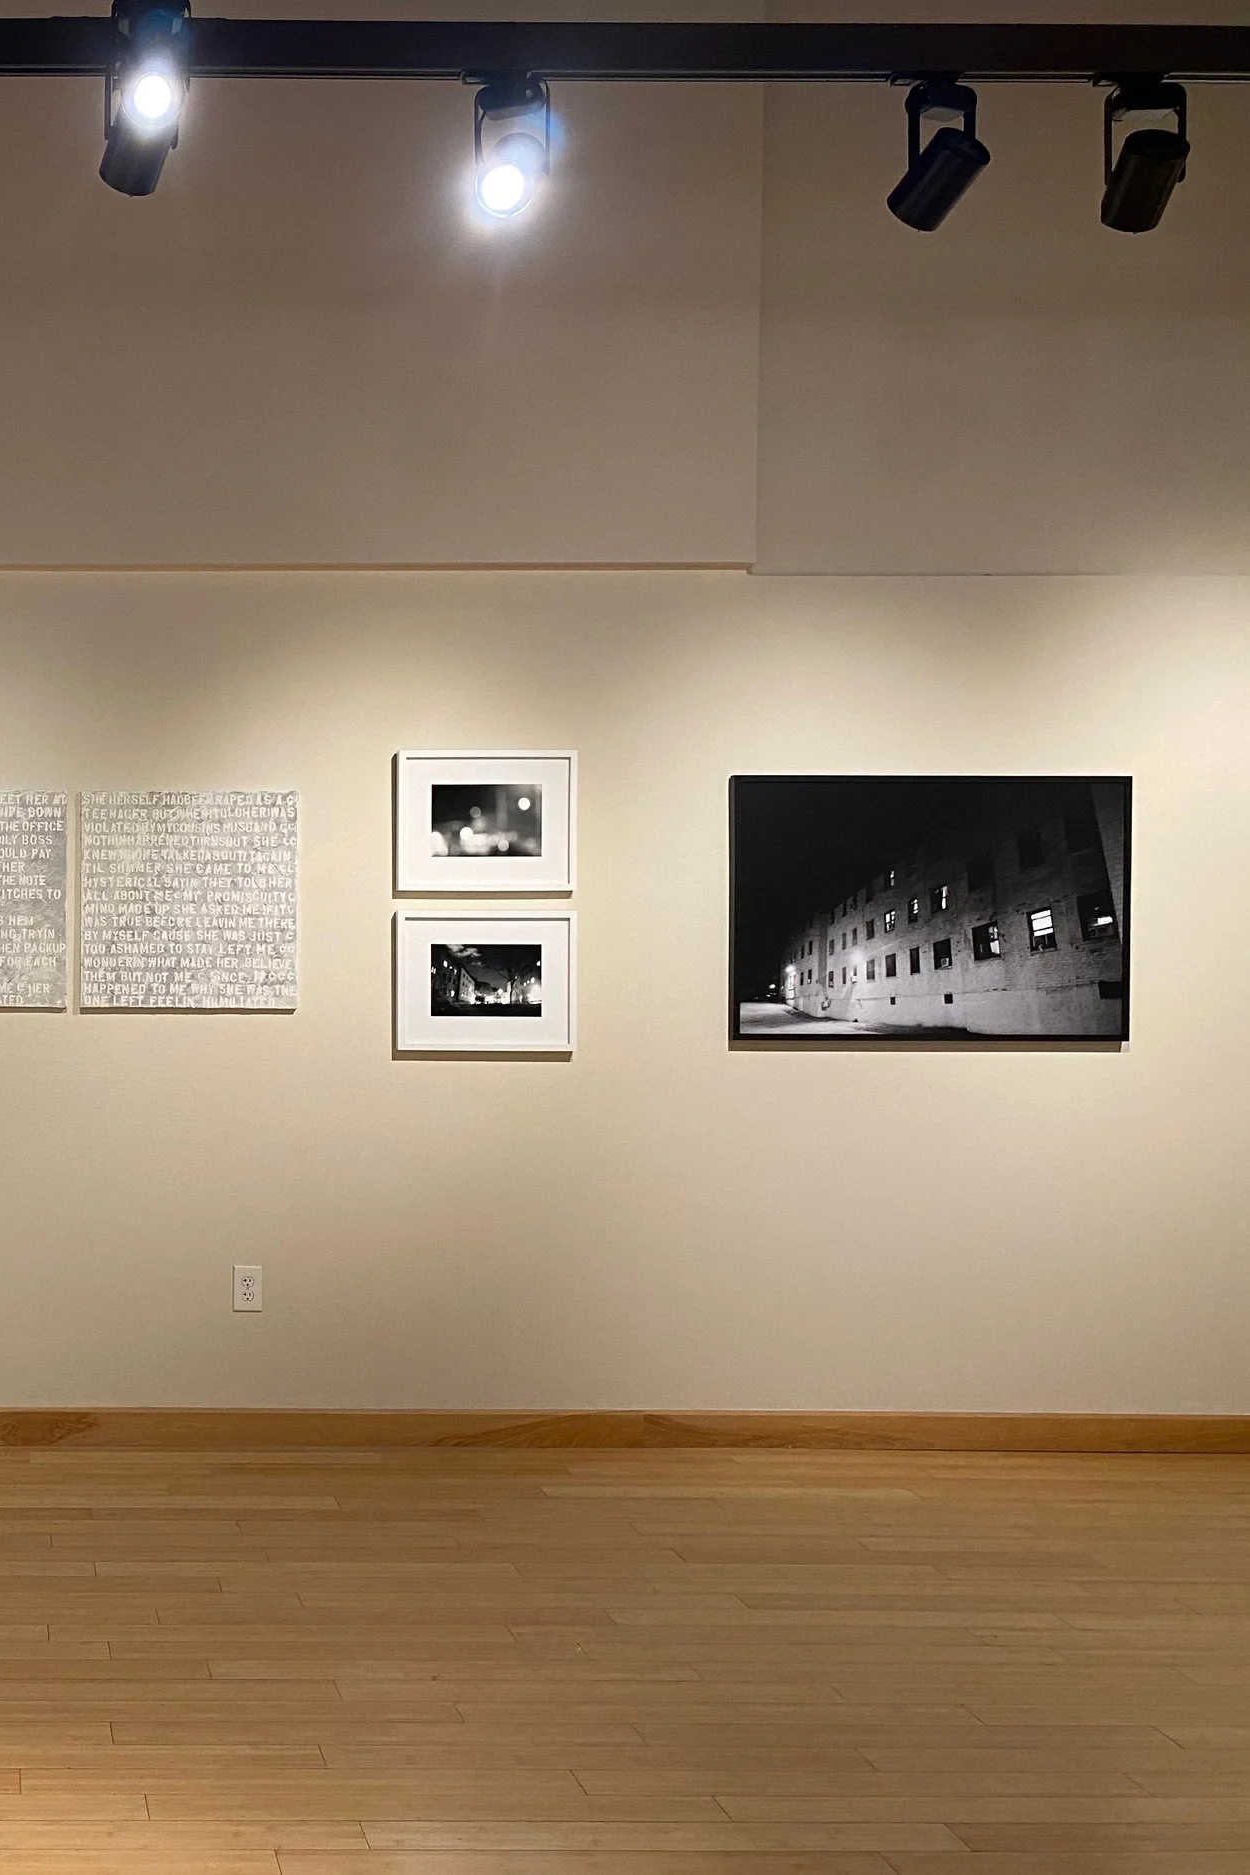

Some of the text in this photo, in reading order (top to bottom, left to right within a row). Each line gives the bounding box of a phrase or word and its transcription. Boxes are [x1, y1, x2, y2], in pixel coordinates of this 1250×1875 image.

[26, 794, 48, 805] HER
[110, 794, 159, 805] HERSELF
[216, 794, 252, 805] RAPED
[256, 794, 271, 805] AS
[84, 808, 148, 819] TEENAGER
[0, 821, 19, 831] THE
[23, 821, 63, 831] OFFICE
[84, 822, 138, 833] VIOLATED
[22, 834, 52, 845] BOSS
[254, 836, 277, 846] SHE
[32, 848, 51, 859] PAY
[84, 849, 116, 860] KNEW
[3, 861, 25, 872] HER
[110, 864, 251, 874] SUMMER SHE CAME TO
[19, 875, 46, 885] NOTE
[164, 877, 291, 888] SAYIN THEY HER
[47, 888, 61, 899] TO
[207, 891, 286, 901] PROMISCUITY
[84, 904, 259, 914] MIND MADE UP SHE ASKED ME
[9, 915, 33, 925] HEM
[84, 917, 294, 928] WAS TRUE BEFORE LEAVIN ME THERE
[21, 929, 54, 939] TRYIN
[84, 931, 282, 941] BY MYSELF SHE WAS JUST
[84, 944, 275, 954] TOO ASHAMED TO STAY LEFT ME
[0, 956, 21, 967] FOR
[26, 956, 57, 967] EACH
[84, 957, 292, 968] WONDERIN WHAT MADE HER BELIEVE
[84, 972, 191, 983] THEM BUT NOT ME
[0, 983, 12, 993] ME
[84, 985, 244, 996] HAPPENED TO ME SHE
